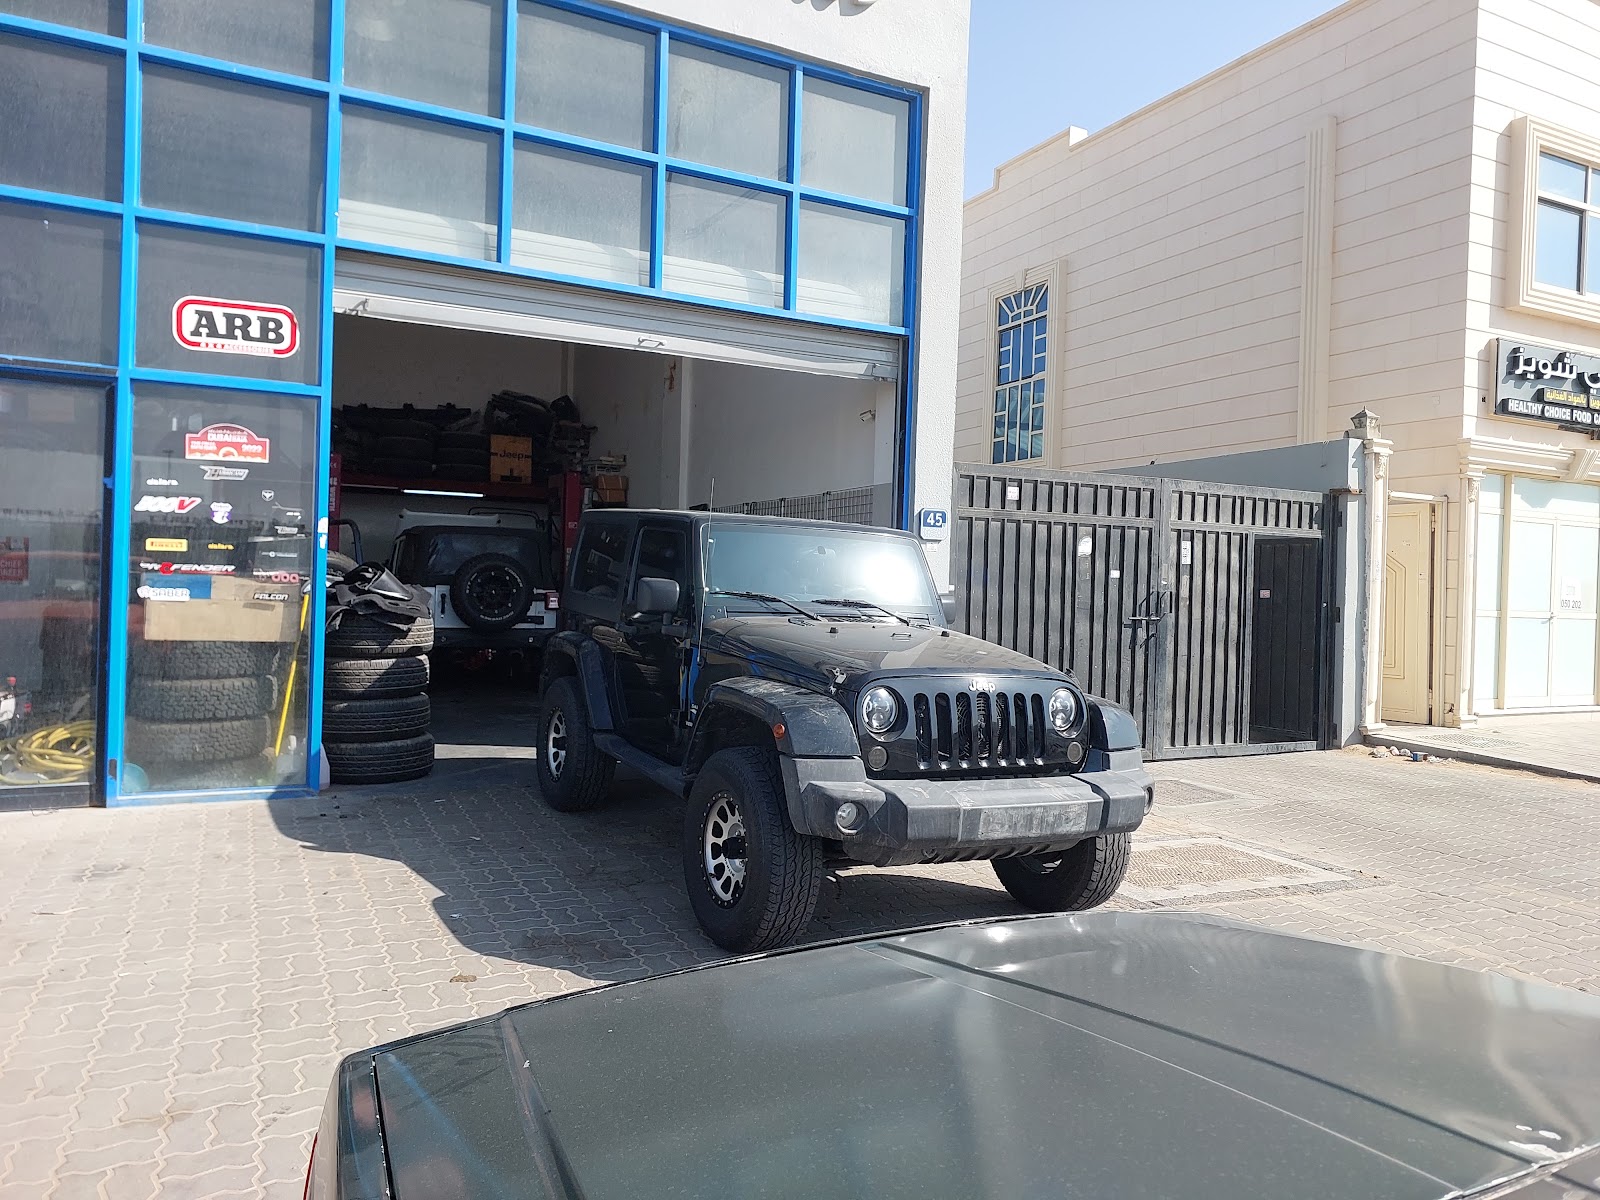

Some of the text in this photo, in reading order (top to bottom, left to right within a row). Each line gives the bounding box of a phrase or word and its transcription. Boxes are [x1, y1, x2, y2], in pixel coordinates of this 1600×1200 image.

[190, 309, 284, 345] ARB
[1508, 399, 1543, 415] HEALTHY
[1544, 405, 1571, 420] CHOICE
[1573, 410, 1592, 424] FOOD
[499, 450, 525, 462] Jeep
[926, 512, 943, 527] 45
[151, 588, 188, 598] SABER
[253, 592, 289, 601] FALCON
[968, 679, 996, 693] Jeep
